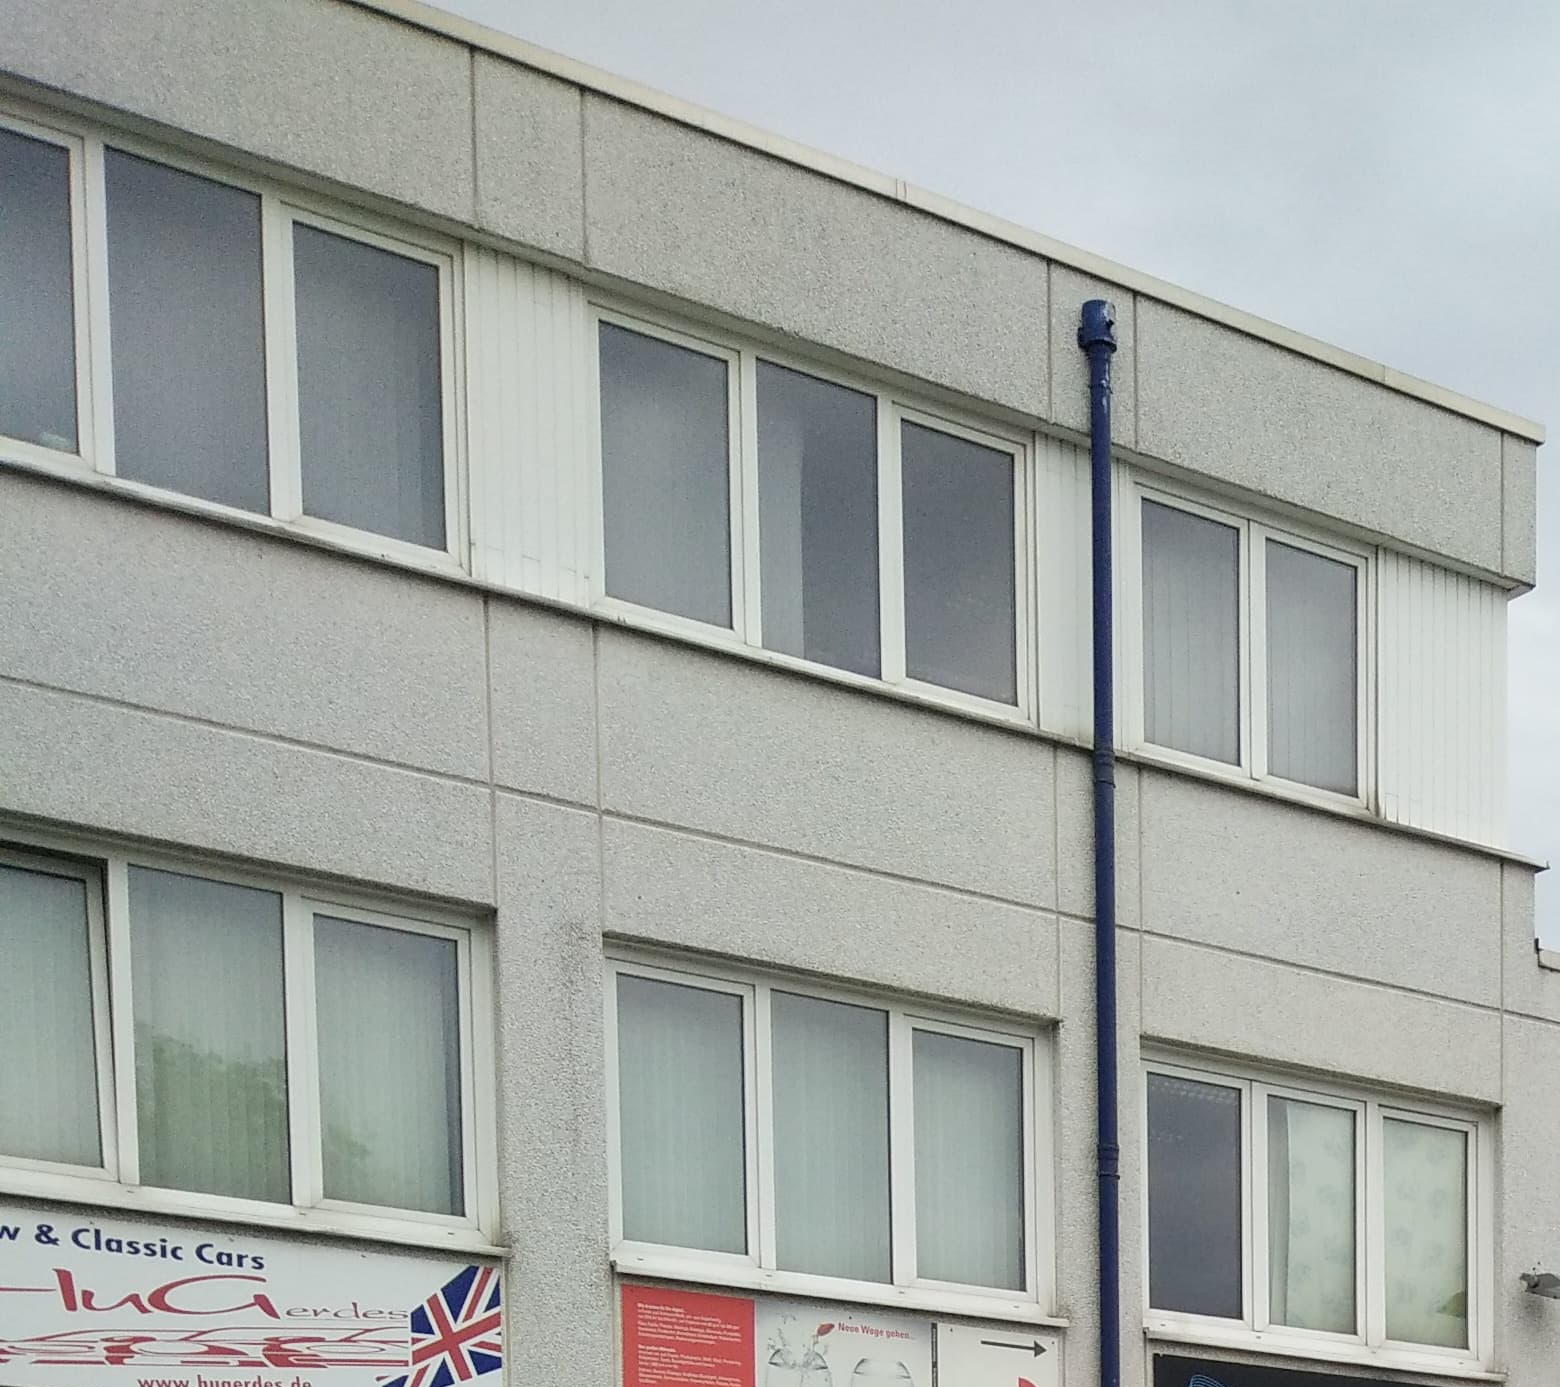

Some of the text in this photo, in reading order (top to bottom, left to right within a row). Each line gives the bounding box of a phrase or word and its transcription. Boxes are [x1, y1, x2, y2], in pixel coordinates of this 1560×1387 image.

[35, 1224, 59, 1246] &
[72, 1228, 183, 1260] Classic
[195, 1244, 265, 1270] Cars
